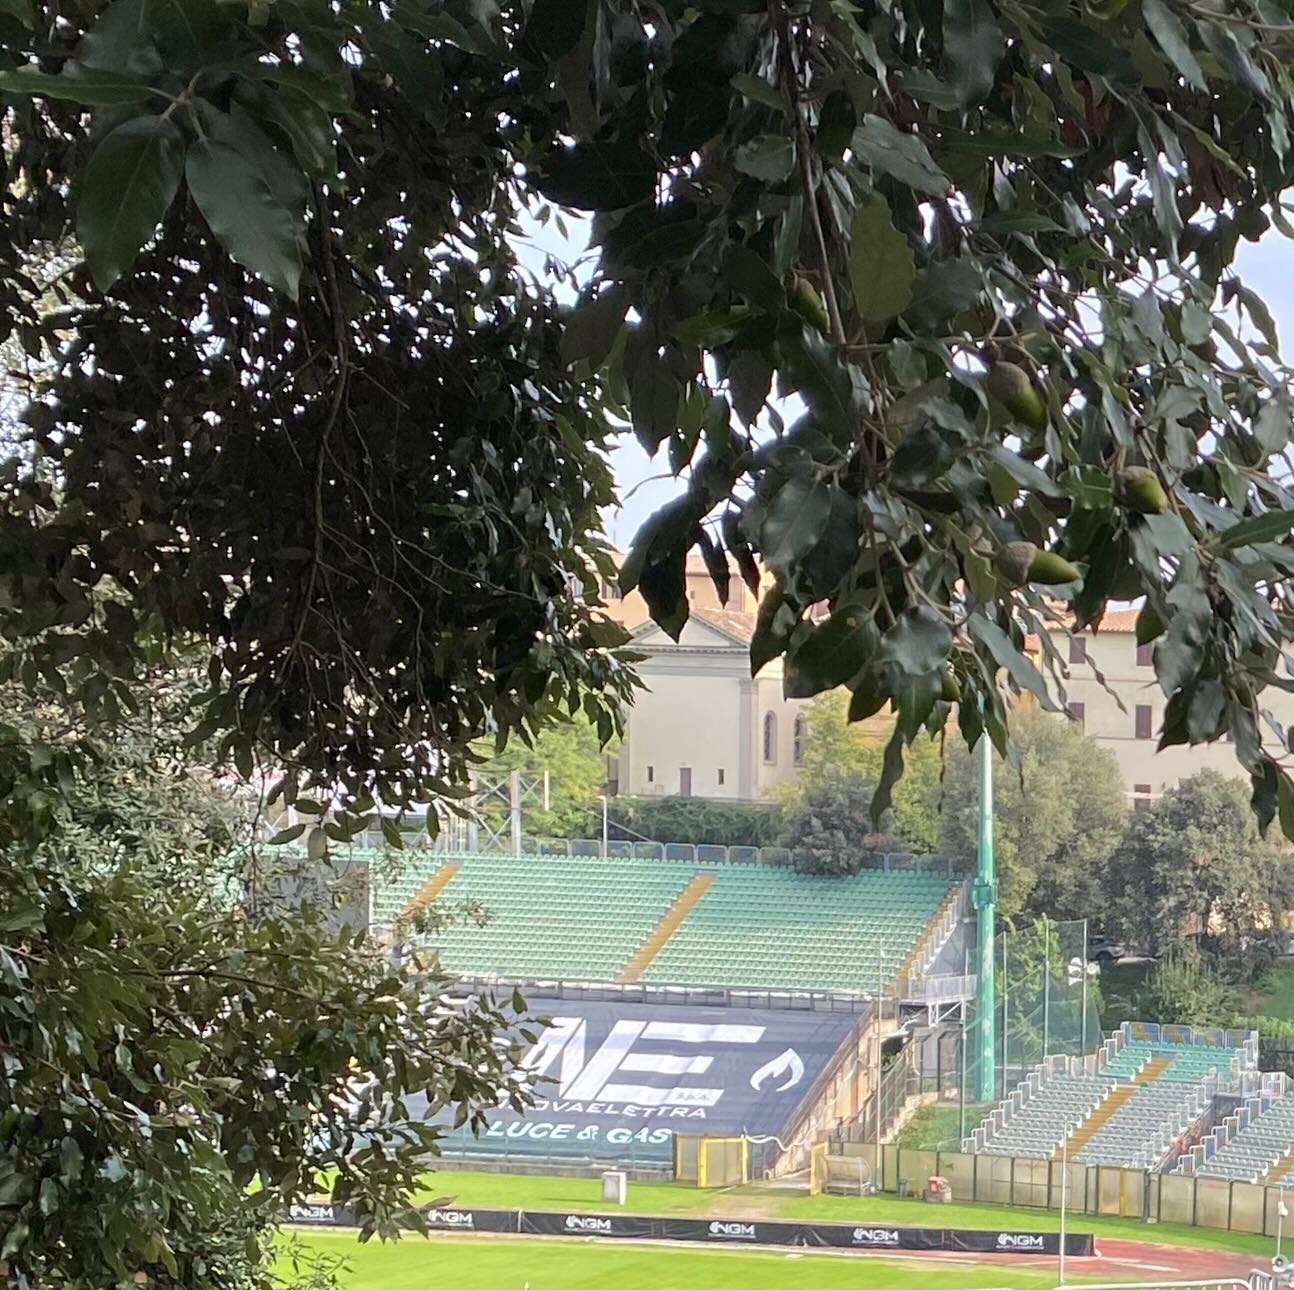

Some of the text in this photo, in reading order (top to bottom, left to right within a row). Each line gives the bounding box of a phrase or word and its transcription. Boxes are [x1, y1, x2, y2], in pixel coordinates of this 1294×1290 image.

[486, 1120, 673, 1144] LUCE & GAS
[427, 1209, 473, 1223] NGM
[565, 1215, 611, 1230] NGM
[709, 1221, 755, 1235] NGM
[853, 1227, 899, 1241] NGM
[998, 1232, 1043, 1246] NGM
